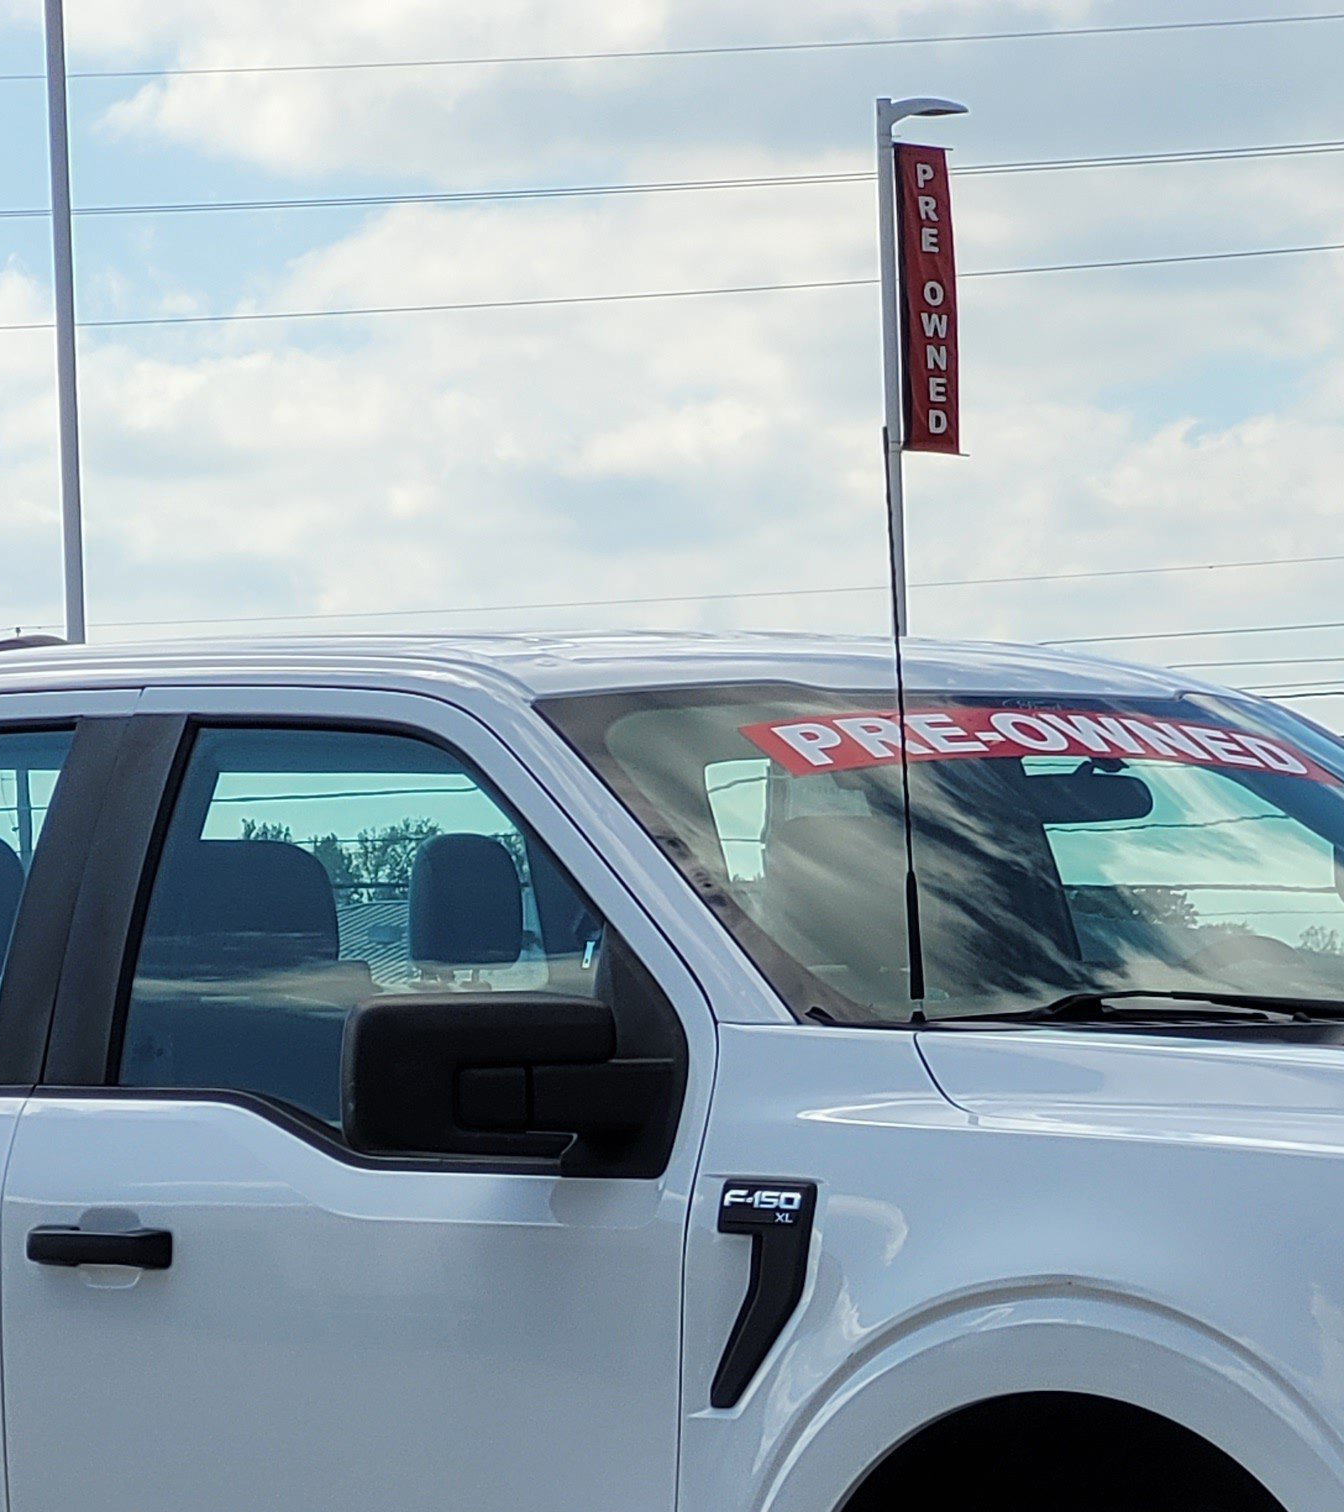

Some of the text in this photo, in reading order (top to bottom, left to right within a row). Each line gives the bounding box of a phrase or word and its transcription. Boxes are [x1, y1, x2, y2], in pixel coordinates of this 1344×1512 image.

[916, 163, 948, 434] PRE OWNED
[771, 713, 1307, 775] PRE-OWNED
[723, 1189, 802, 1210] F-150
[775, 1212, 794, 1224] XL
